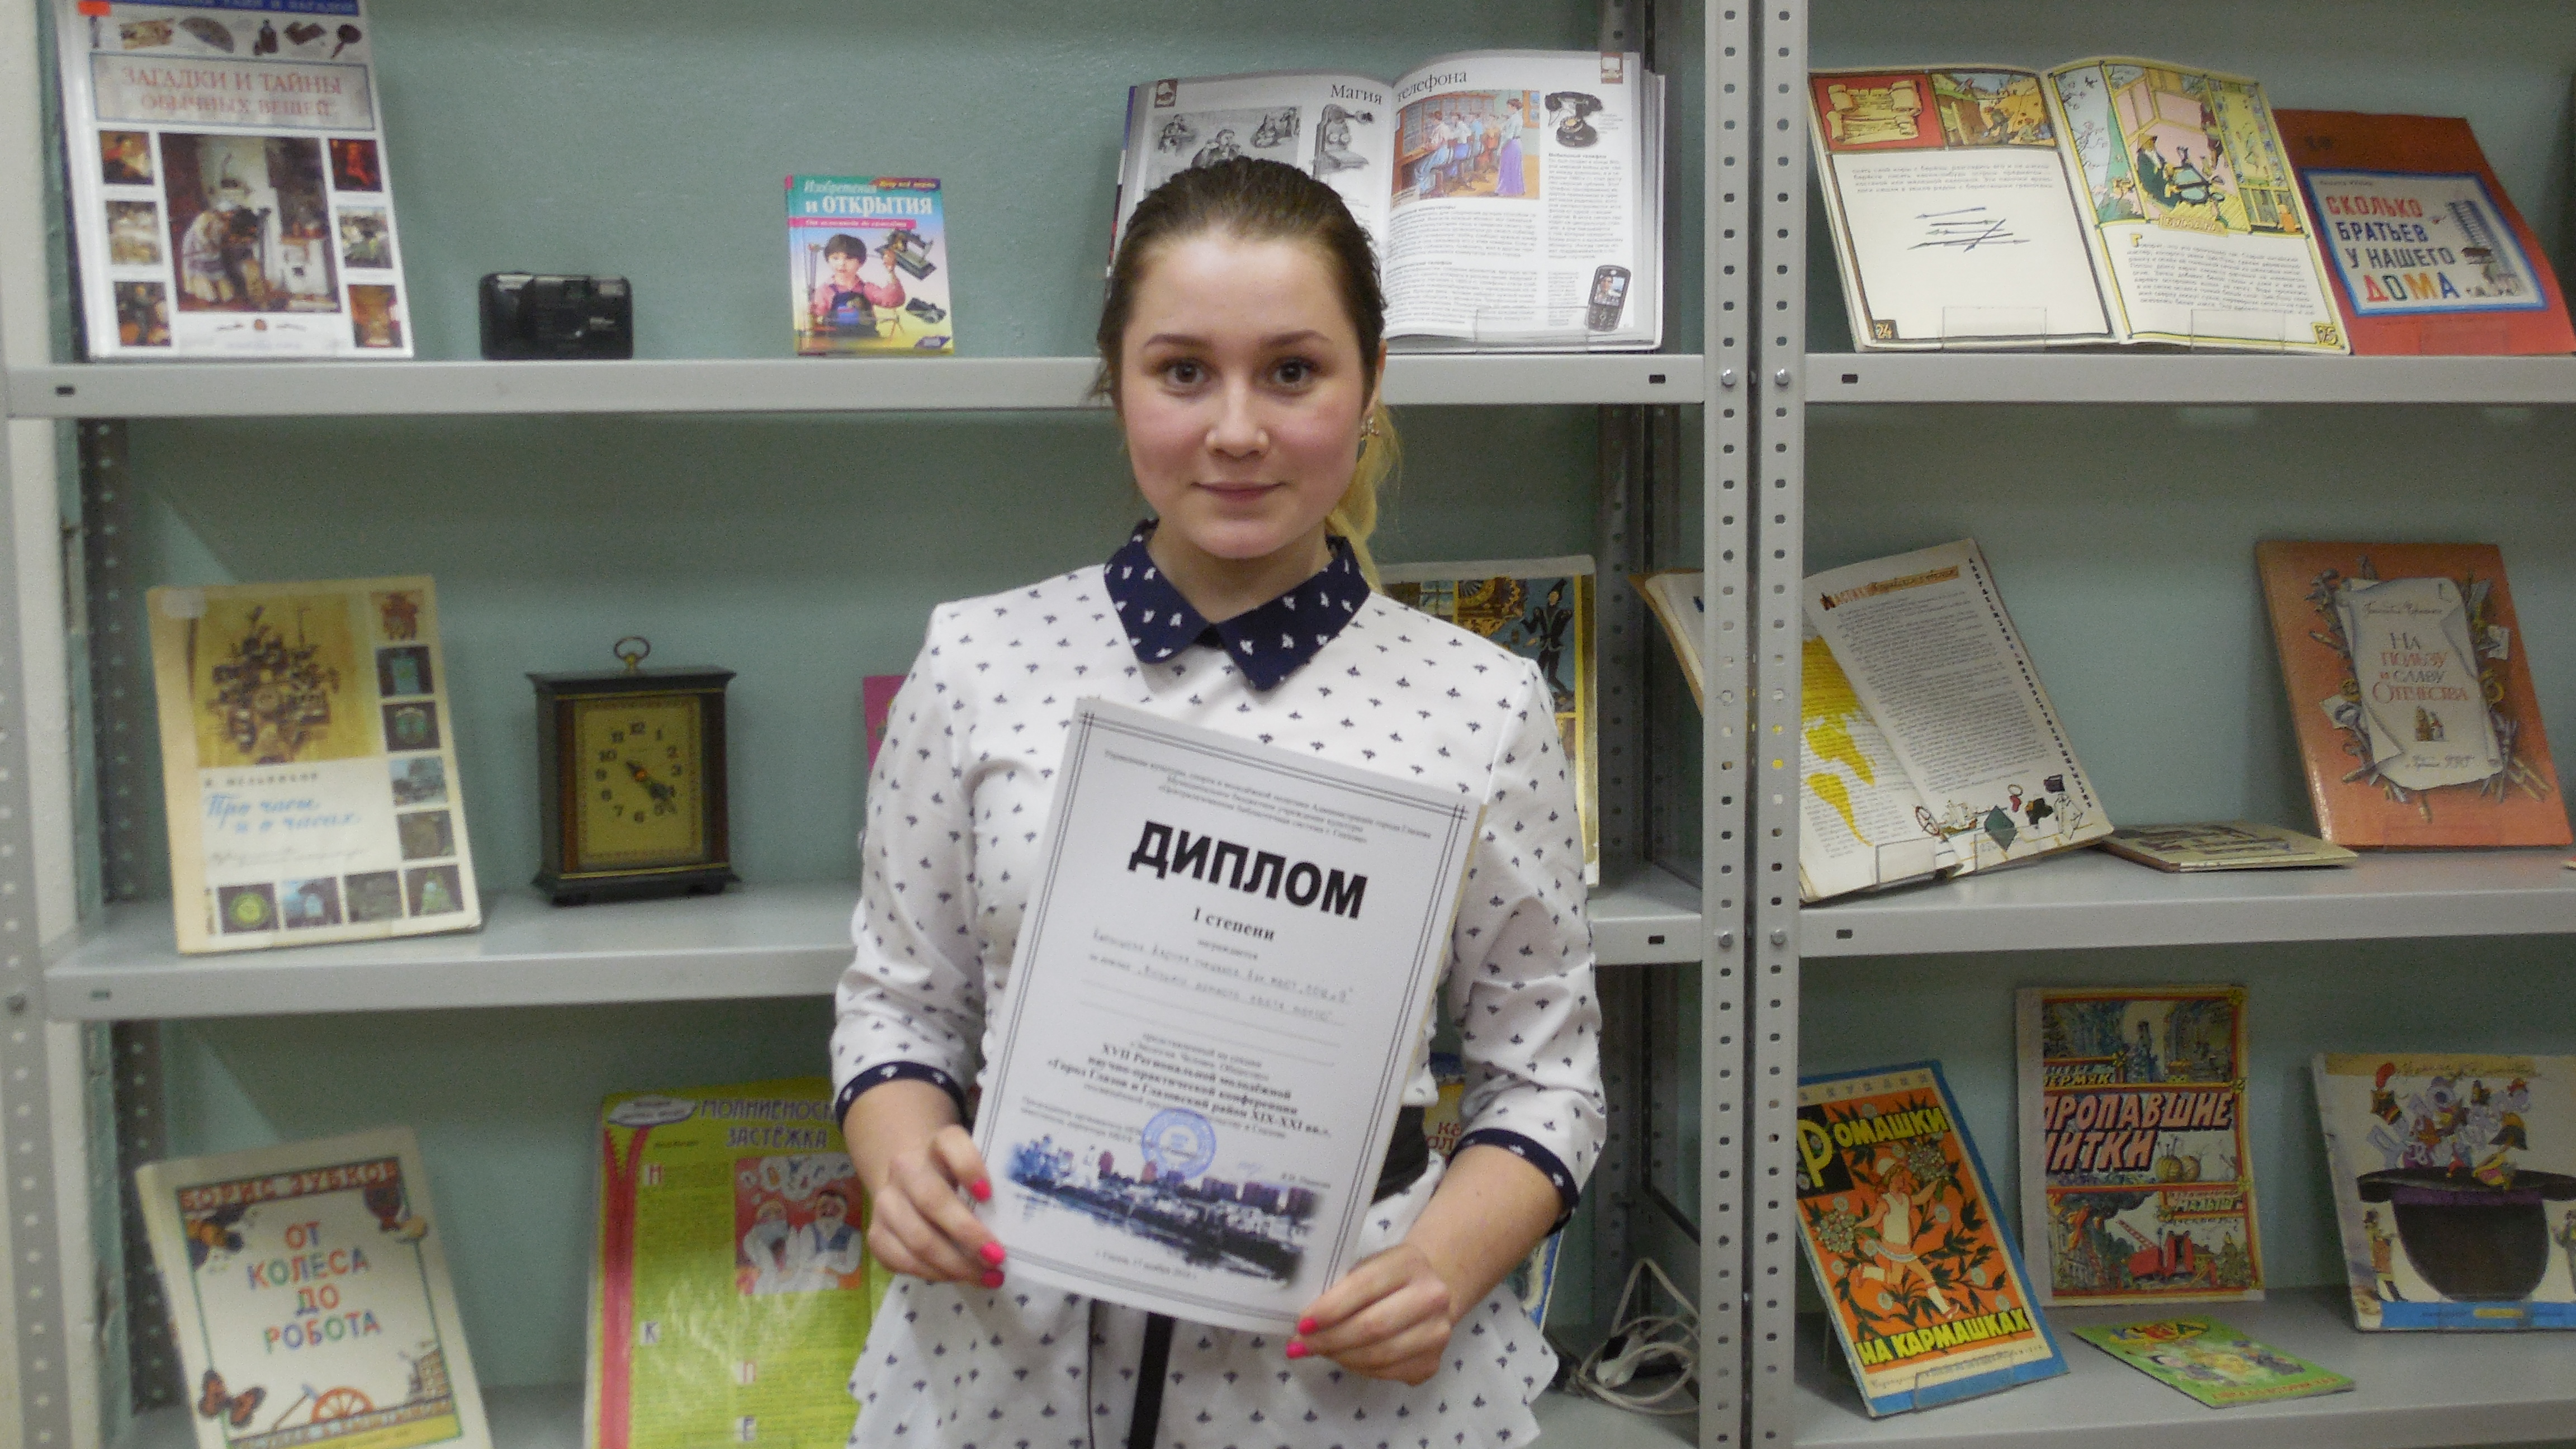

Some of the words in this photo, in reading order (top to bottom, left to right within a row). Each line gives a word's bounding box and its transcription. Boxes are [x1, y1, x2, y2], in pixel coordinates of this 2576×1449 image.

[1330, 83, 1383, 105] Магия
[2326, 196, 2423, 218] СКОЛЬКО
[2336, 221, 2430, 243] БРАТЬЕВ
[2345, 247, 2359, 269] У
[2366, 247, 2456, 269] НАШЕГО
[2364, 272, 2460, 303] ДОМА
[1127, 820, 1369, 920] ДИПЛОМ
[1205, 911, 1276, 943] степени
[284, 1220, 320, 1250] ОТ
[245, 1247, 371, 1290] КОЛЕСА
[295, 1285, 340, 1316] ДО
[263, 1309, 382, 1355] РОБОТА
[1853, 1339, 1893, 1366] НА
[1888, 1308, 2032, 1358] КАРМАШКАХ
